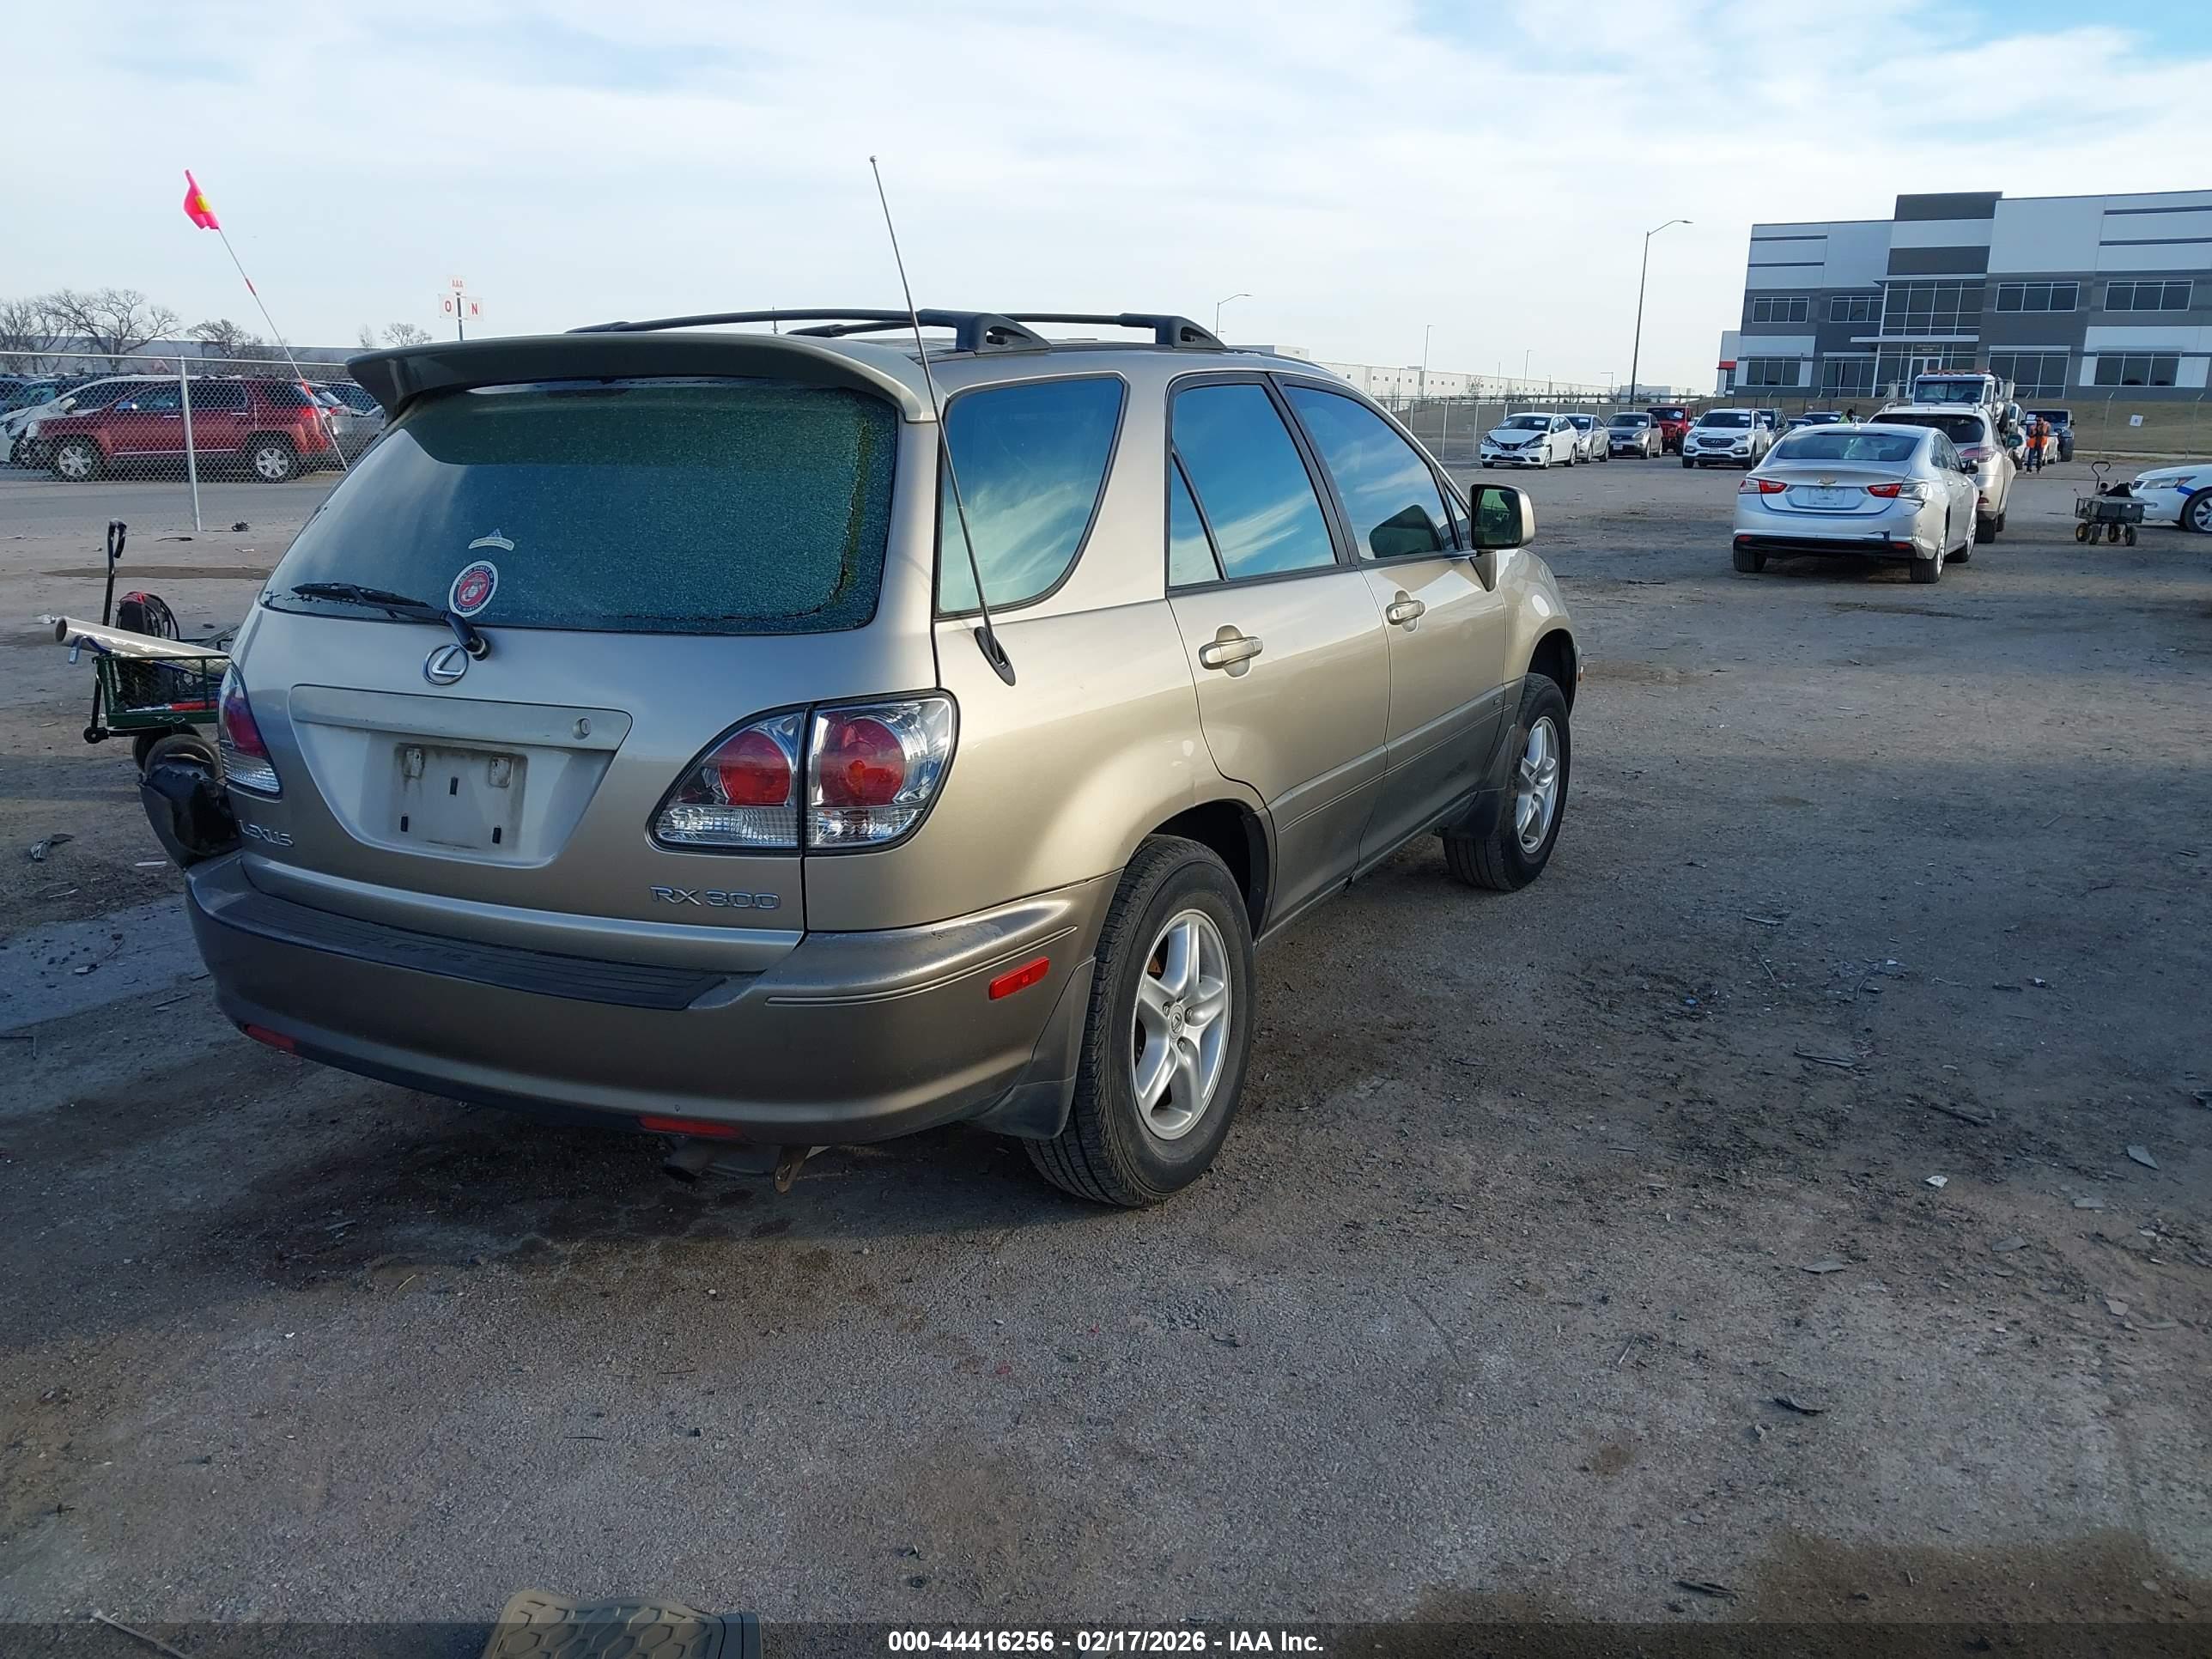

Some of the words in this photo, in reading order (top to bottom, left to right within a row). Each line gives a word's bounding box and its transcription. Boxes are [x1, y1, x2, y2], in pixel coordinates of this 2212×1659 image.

[452, 279, 464, 289] AAA
[445, 301, 453, 313] O
[471, 302, 478, 315] N
[237, 818, 294, 847] LEXUS
[649, 885, 702, 906] RX
[705, 890, 781, 909] 300
